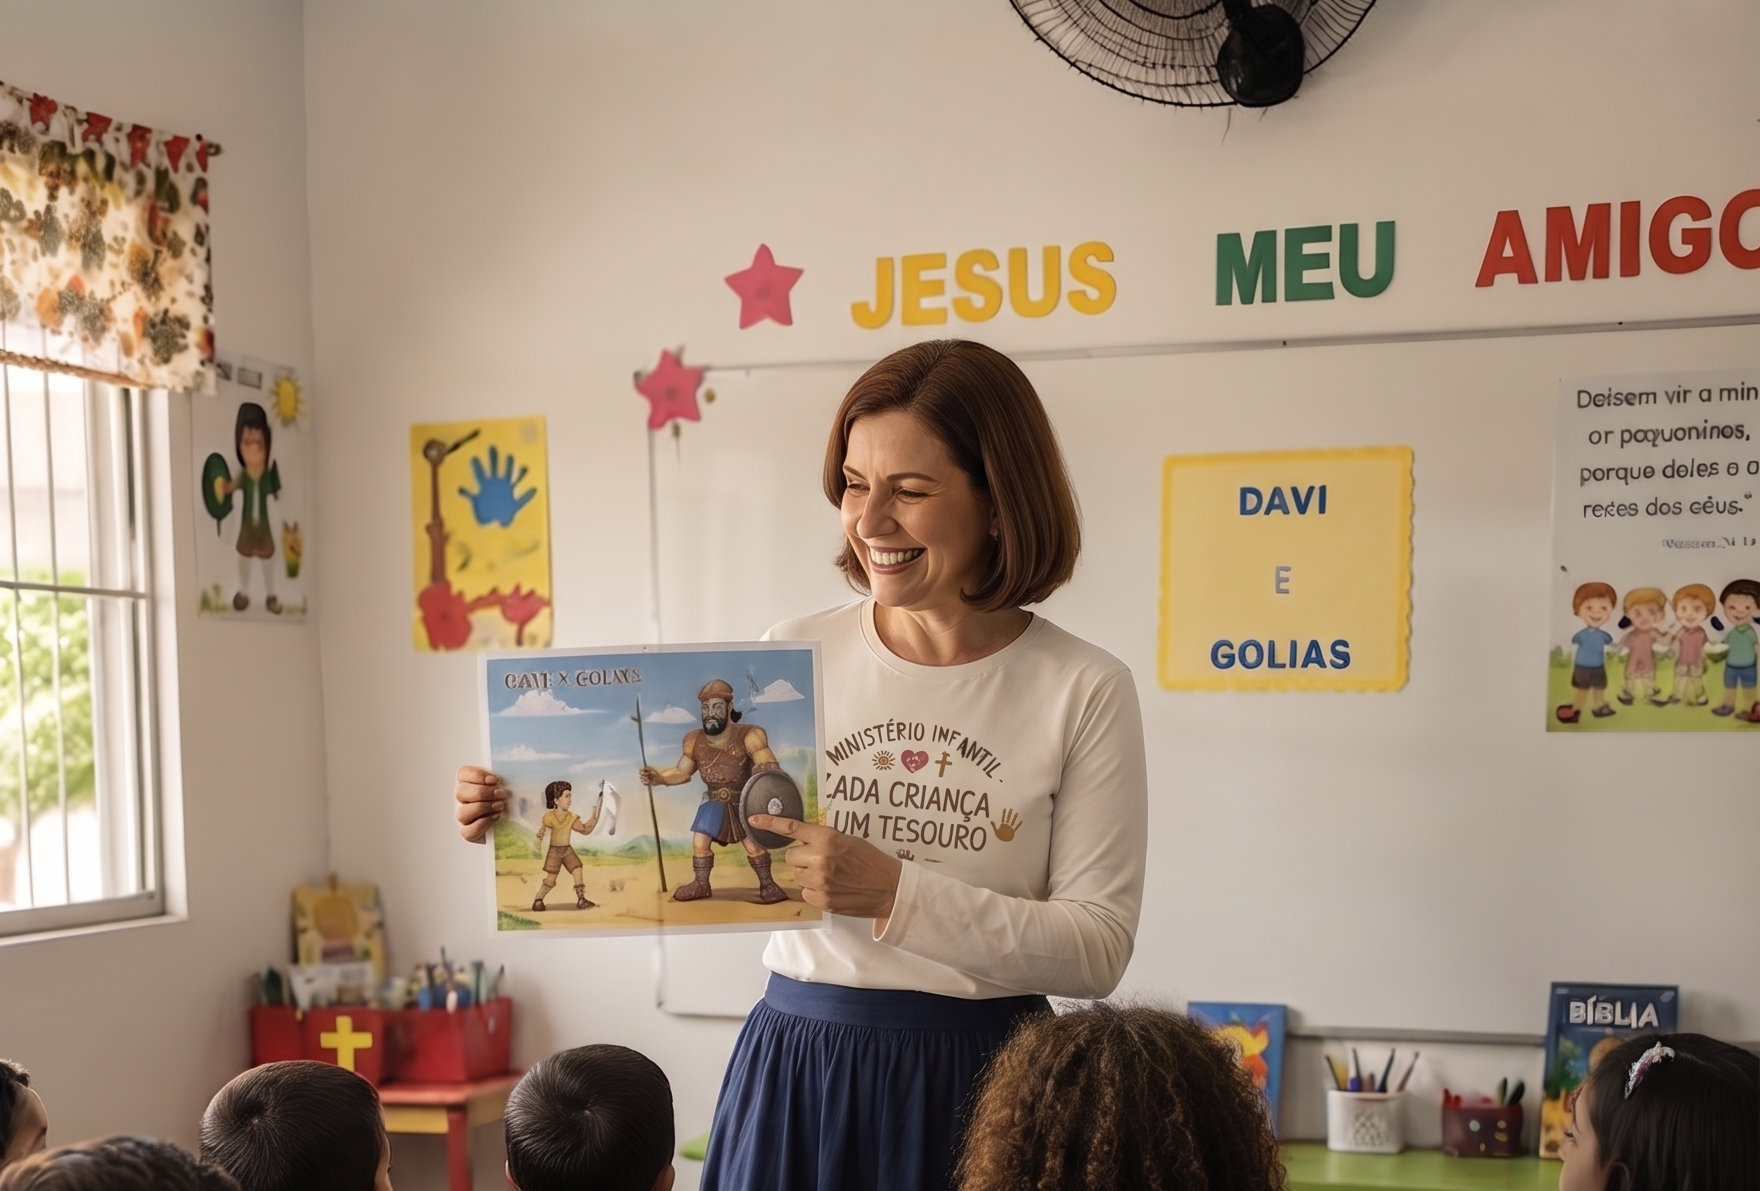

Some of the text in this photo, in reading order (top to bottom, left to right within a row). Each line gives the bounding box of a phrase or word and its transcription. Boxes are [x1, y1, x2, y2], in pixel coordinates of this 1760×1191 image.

[851, 241, 1117, 330] JESUS
[1216, 221, 1395, 305] MEU
[1664, 385, 1692, 405] vir
[1699, 388, 1712, 402] a
[1239, 485, 1327, 516] DAVI
[1645, 497, 1682, 516] dos
[1275, 566, 1291, 594] E
[1210, 639, 1351, 670] GOLIAS
[826, 719, 925, 766] MINISTÉRIO
[826, 772, 990, 822] ADA CRIANÇA
[834, 810, 987, 851] UM TESOURO
[1569, 995, 1659, 1029] BÍBLIA
